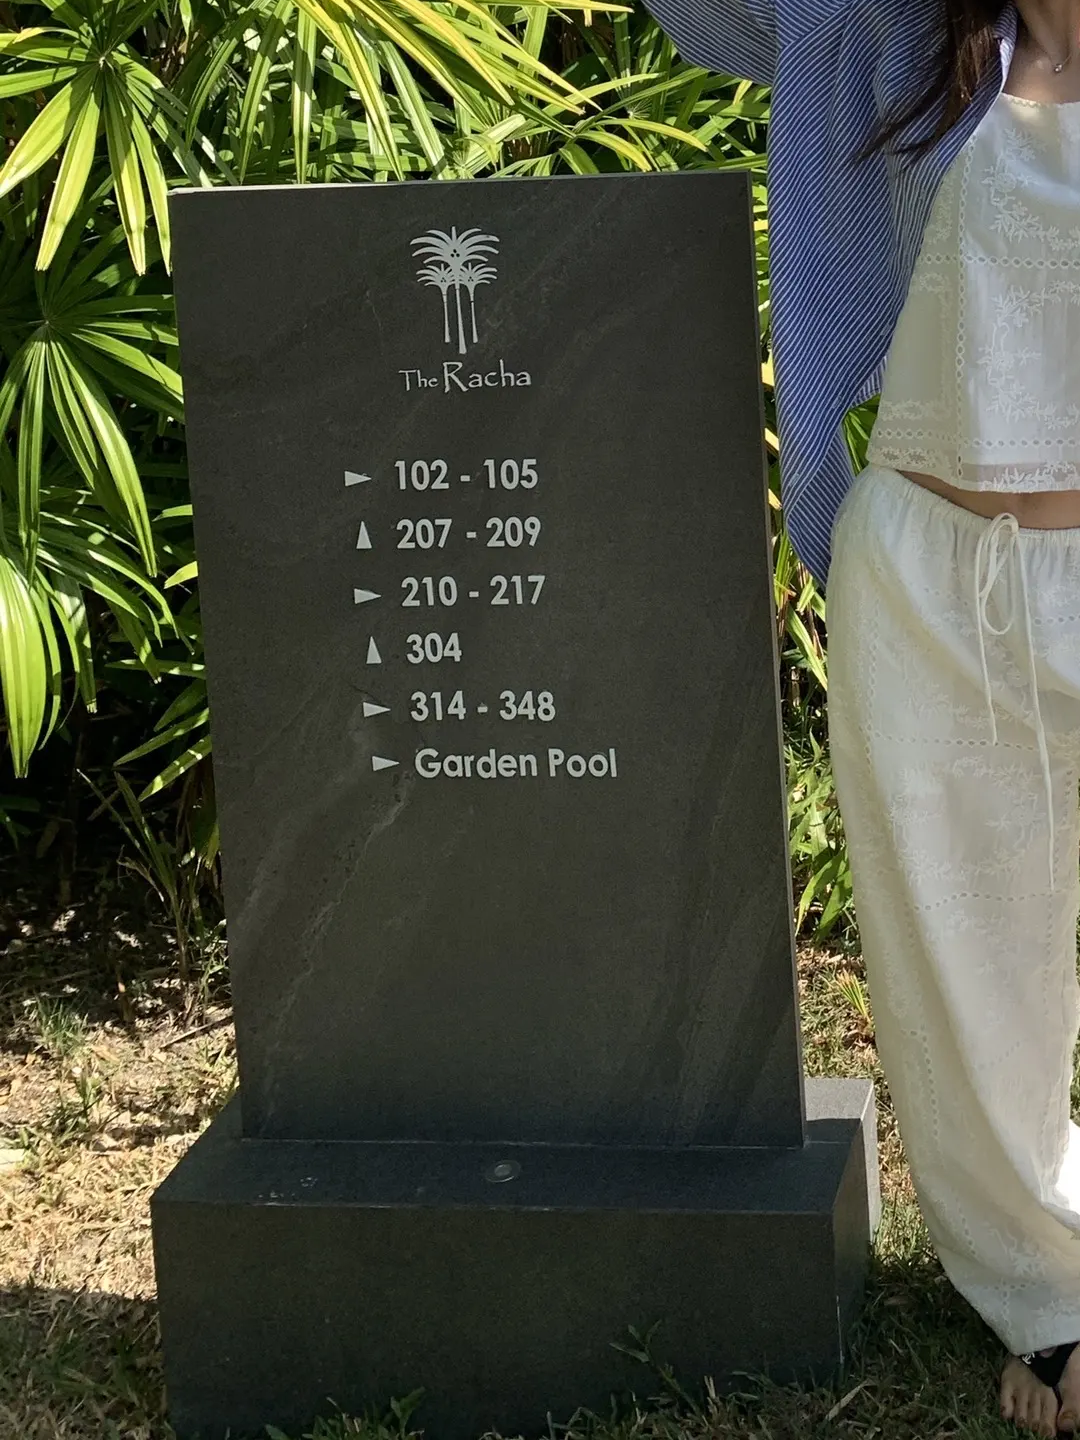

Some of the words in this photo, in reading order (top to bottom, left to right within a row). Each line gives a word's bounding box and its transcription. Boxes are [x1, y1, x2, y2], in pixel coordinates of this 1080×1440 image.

[398, 369, 439, 392] The
[442, 358, 532, 394] Racha
[394, 459, 450, 491] 102
[483, 458, 539, 490] 105
[396, 518, 453, 549] 207
[485, 516, 541, 548] 209
[401, 575, 458, 607] 210
[489, 574, 546, 605] 217
[406, 632, 463, 664] 304
[410, 690, 467, 722] 314
[499, 690, 556, 722] 348
[414, 748, 538, 779] Garden
[548, 748, 618, 778] Pool
